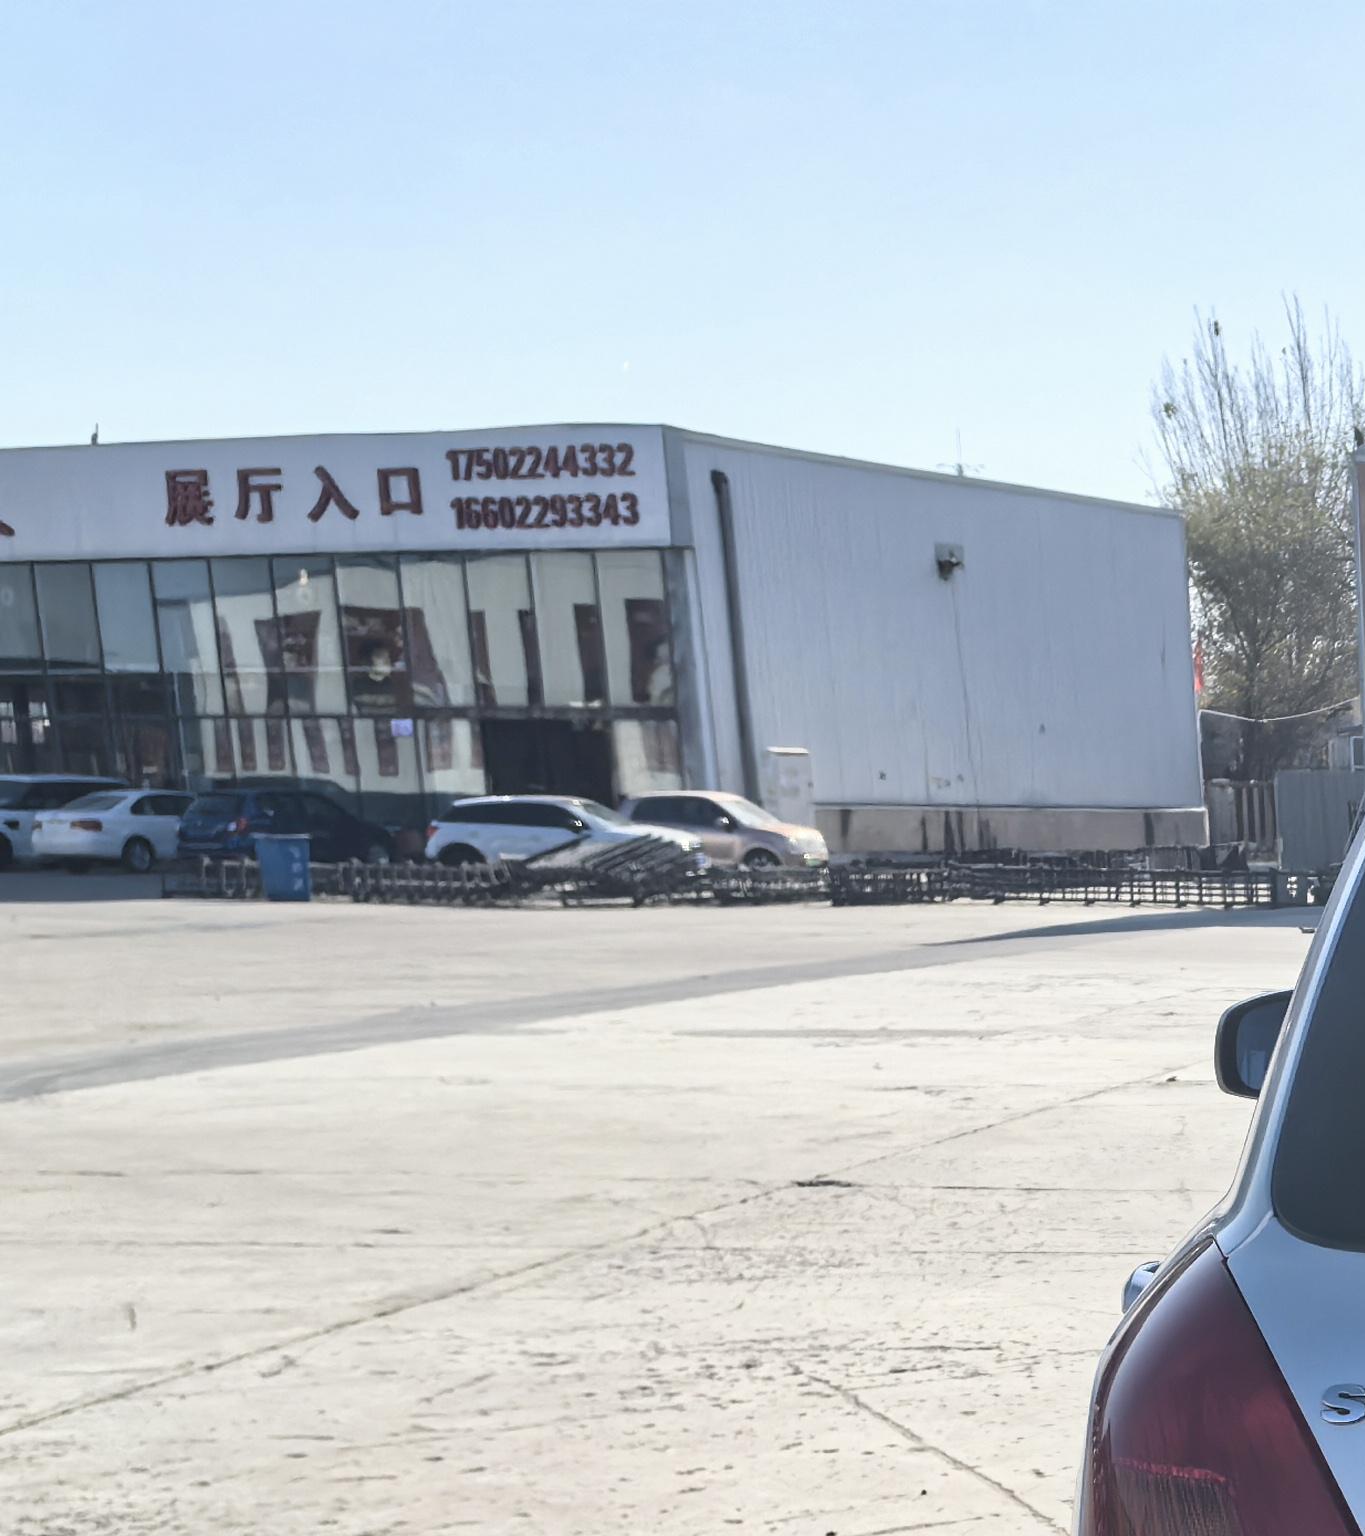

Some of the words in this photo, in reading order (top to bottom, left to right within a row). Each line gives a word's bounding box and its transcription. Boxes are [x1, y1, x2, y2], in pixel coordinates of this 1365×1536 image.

[445, 443, 636, 481] 17502244332
[164, 465, 425, 526] 展厅入口
[450, 492, 641, 530] 16602293343
